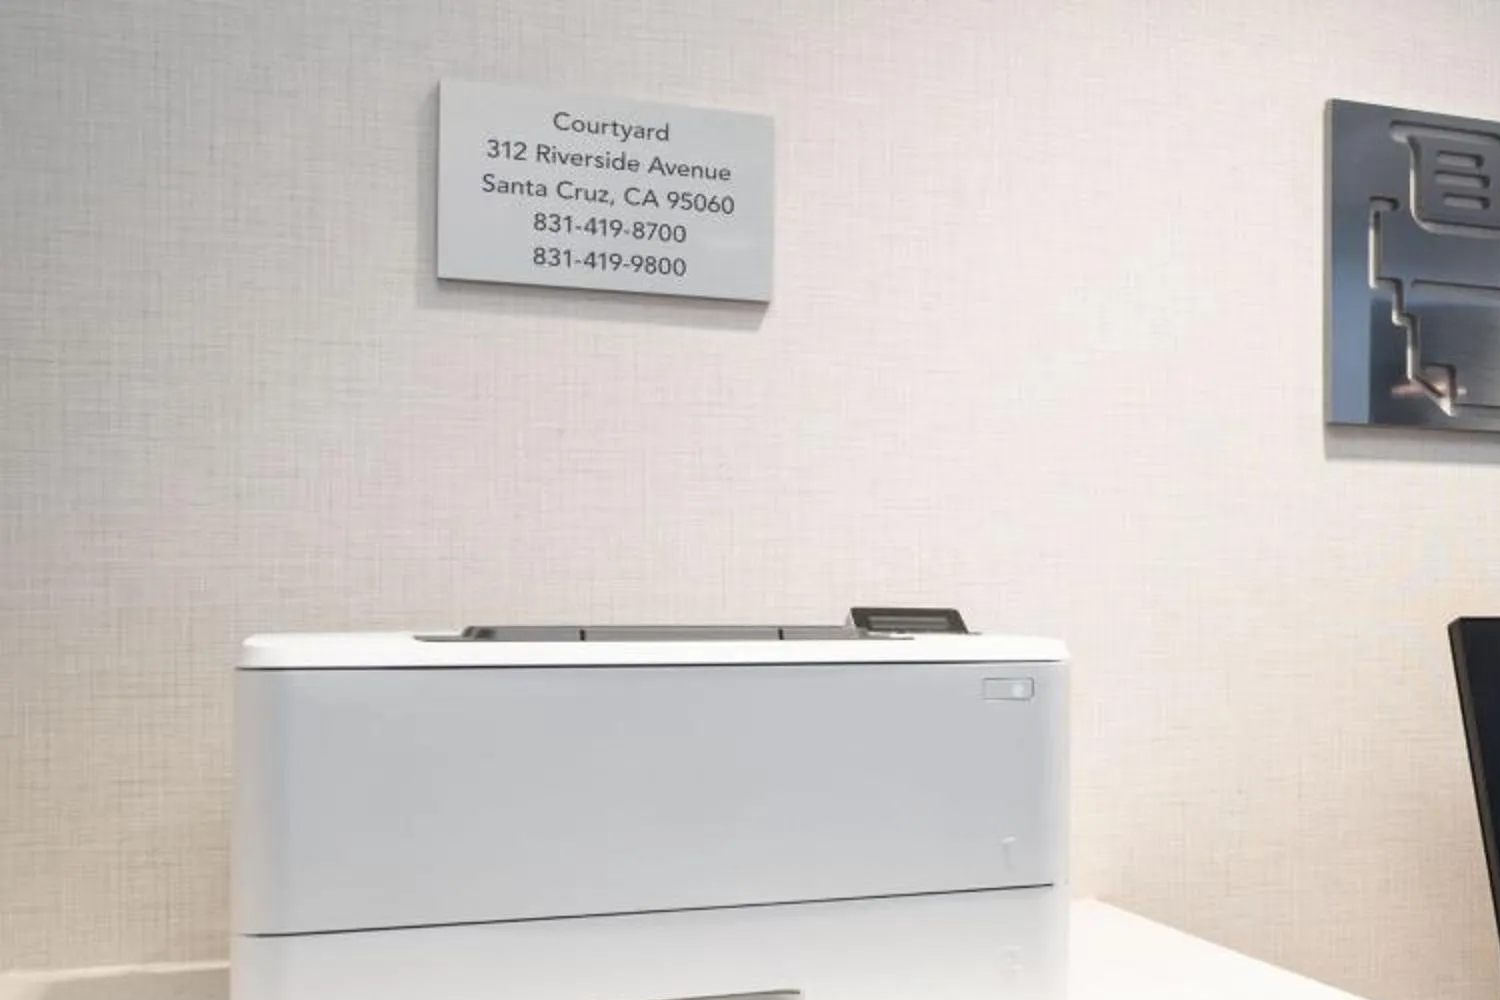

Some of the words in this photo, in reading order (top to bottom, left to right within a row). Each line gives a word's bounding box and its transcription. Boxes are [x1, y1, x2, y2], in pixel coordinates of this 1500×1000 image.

[553, 111, 670, 142] Courtyard
[487, 139, 527, 162] 312
[535, 143, 641, 173] Riverside
[647, 156, 732, 181] Avenue
[481, 173, 548, 198] Santa
[556, 180, 616, 207] Cruz,
[623, 187, 660, 208] CA
[667, 191, 735, 215] 95060
[533, 212, 687, 243] 831-419-8700
[533, 247, 687, 277] 831-419-9800
